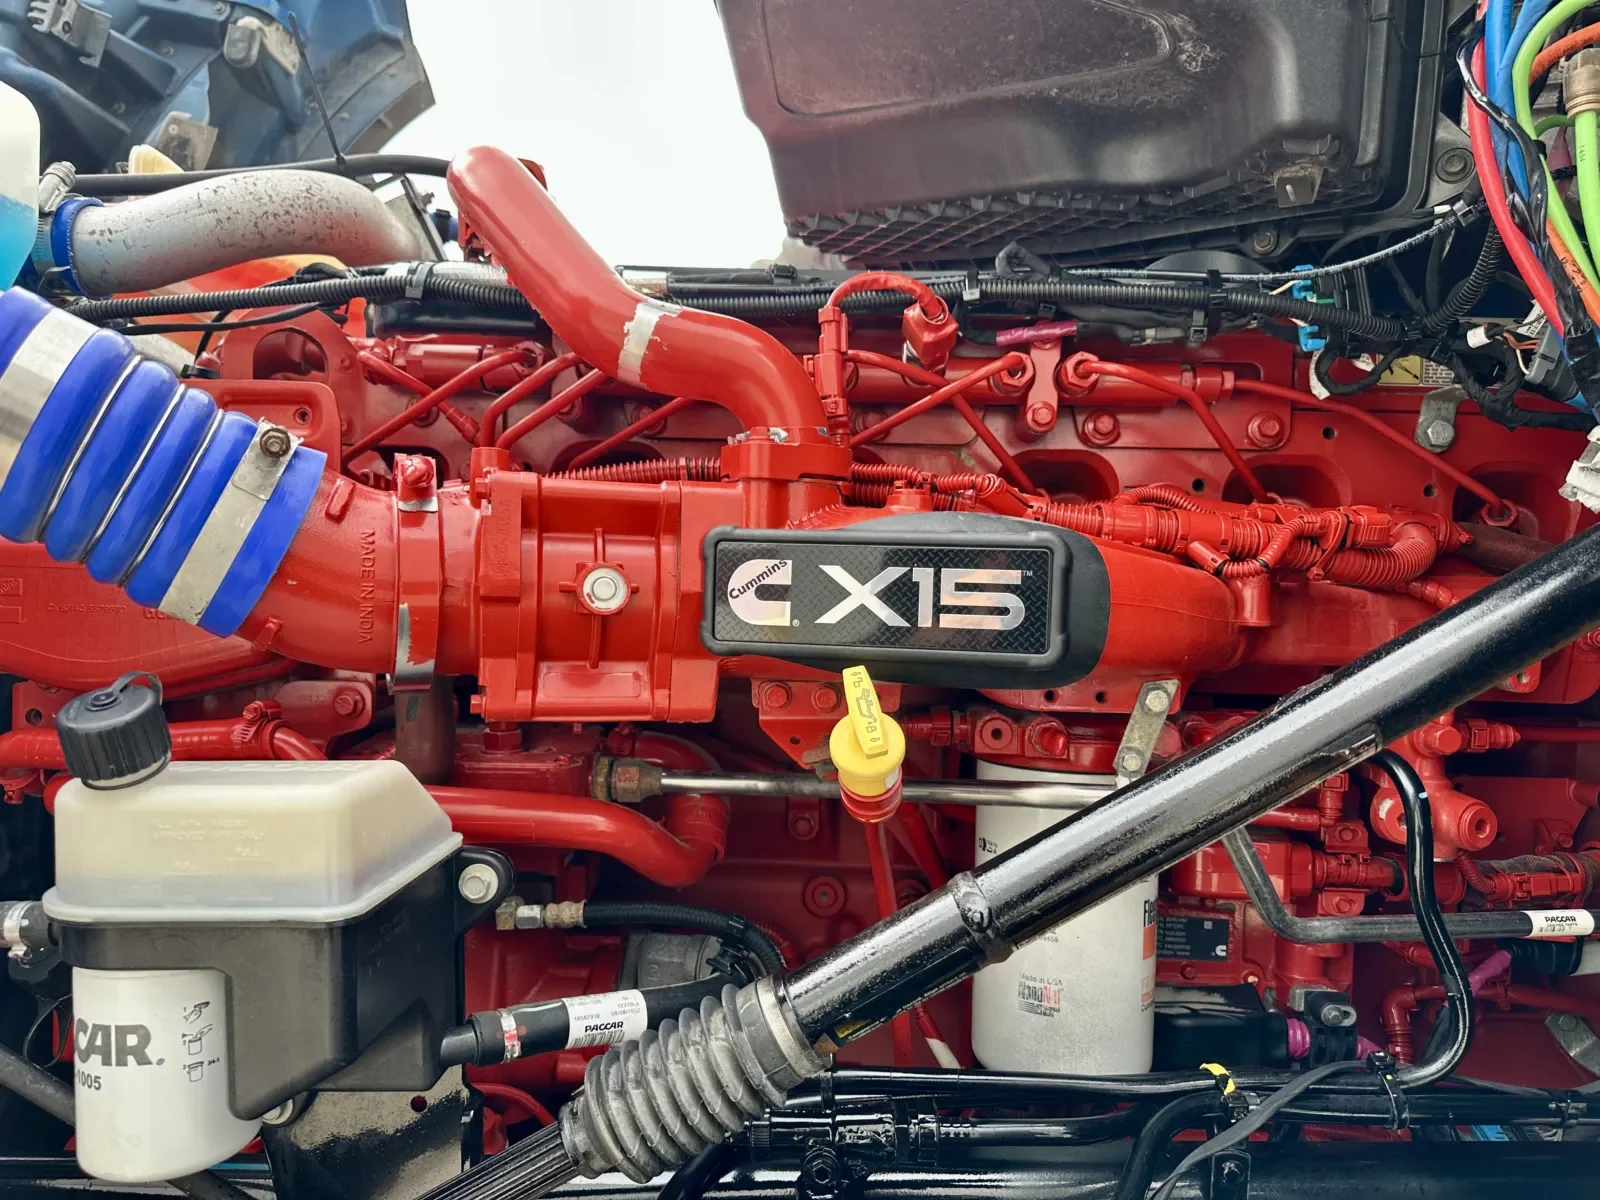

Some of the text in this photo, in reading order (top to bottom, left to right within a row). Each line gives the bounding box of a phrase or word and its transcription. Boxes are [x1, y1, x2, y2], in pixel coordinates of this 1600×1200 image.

[358, 530, 376, 645] MADE IN INDIA
[729, 559, 788, 600] Cummins
[814, 563, 1026, 631] X15
[1046, 977, 1064, 987] USA
[584, 1021, 624, 1032] PACCAR
